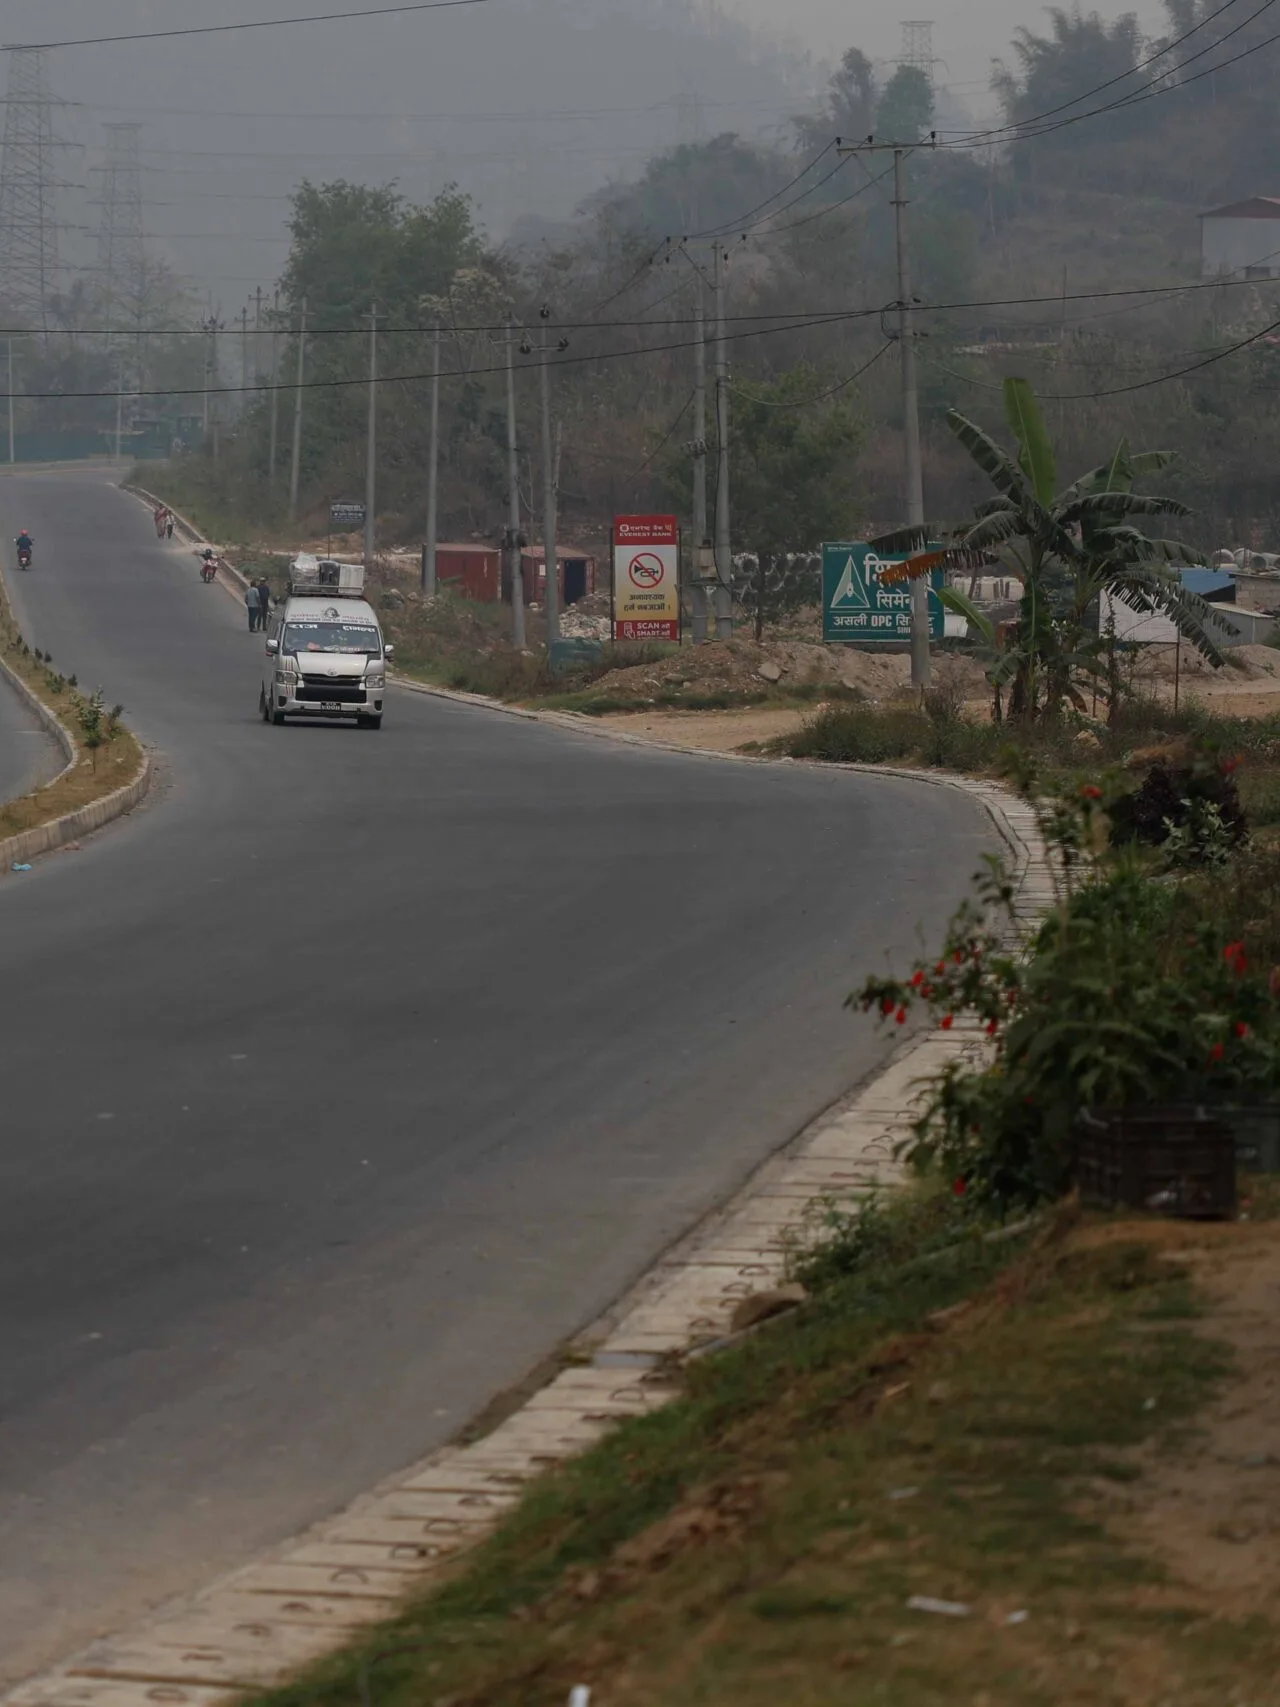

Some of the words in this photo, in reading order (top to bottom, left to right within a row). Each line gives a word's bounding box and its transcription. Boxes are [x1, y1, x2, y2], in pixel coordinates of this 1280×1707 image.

[833, 613, 868, 626] असली
[870, 615, 892, 627] OPC
[636, 622, 660, 630] SCAN
